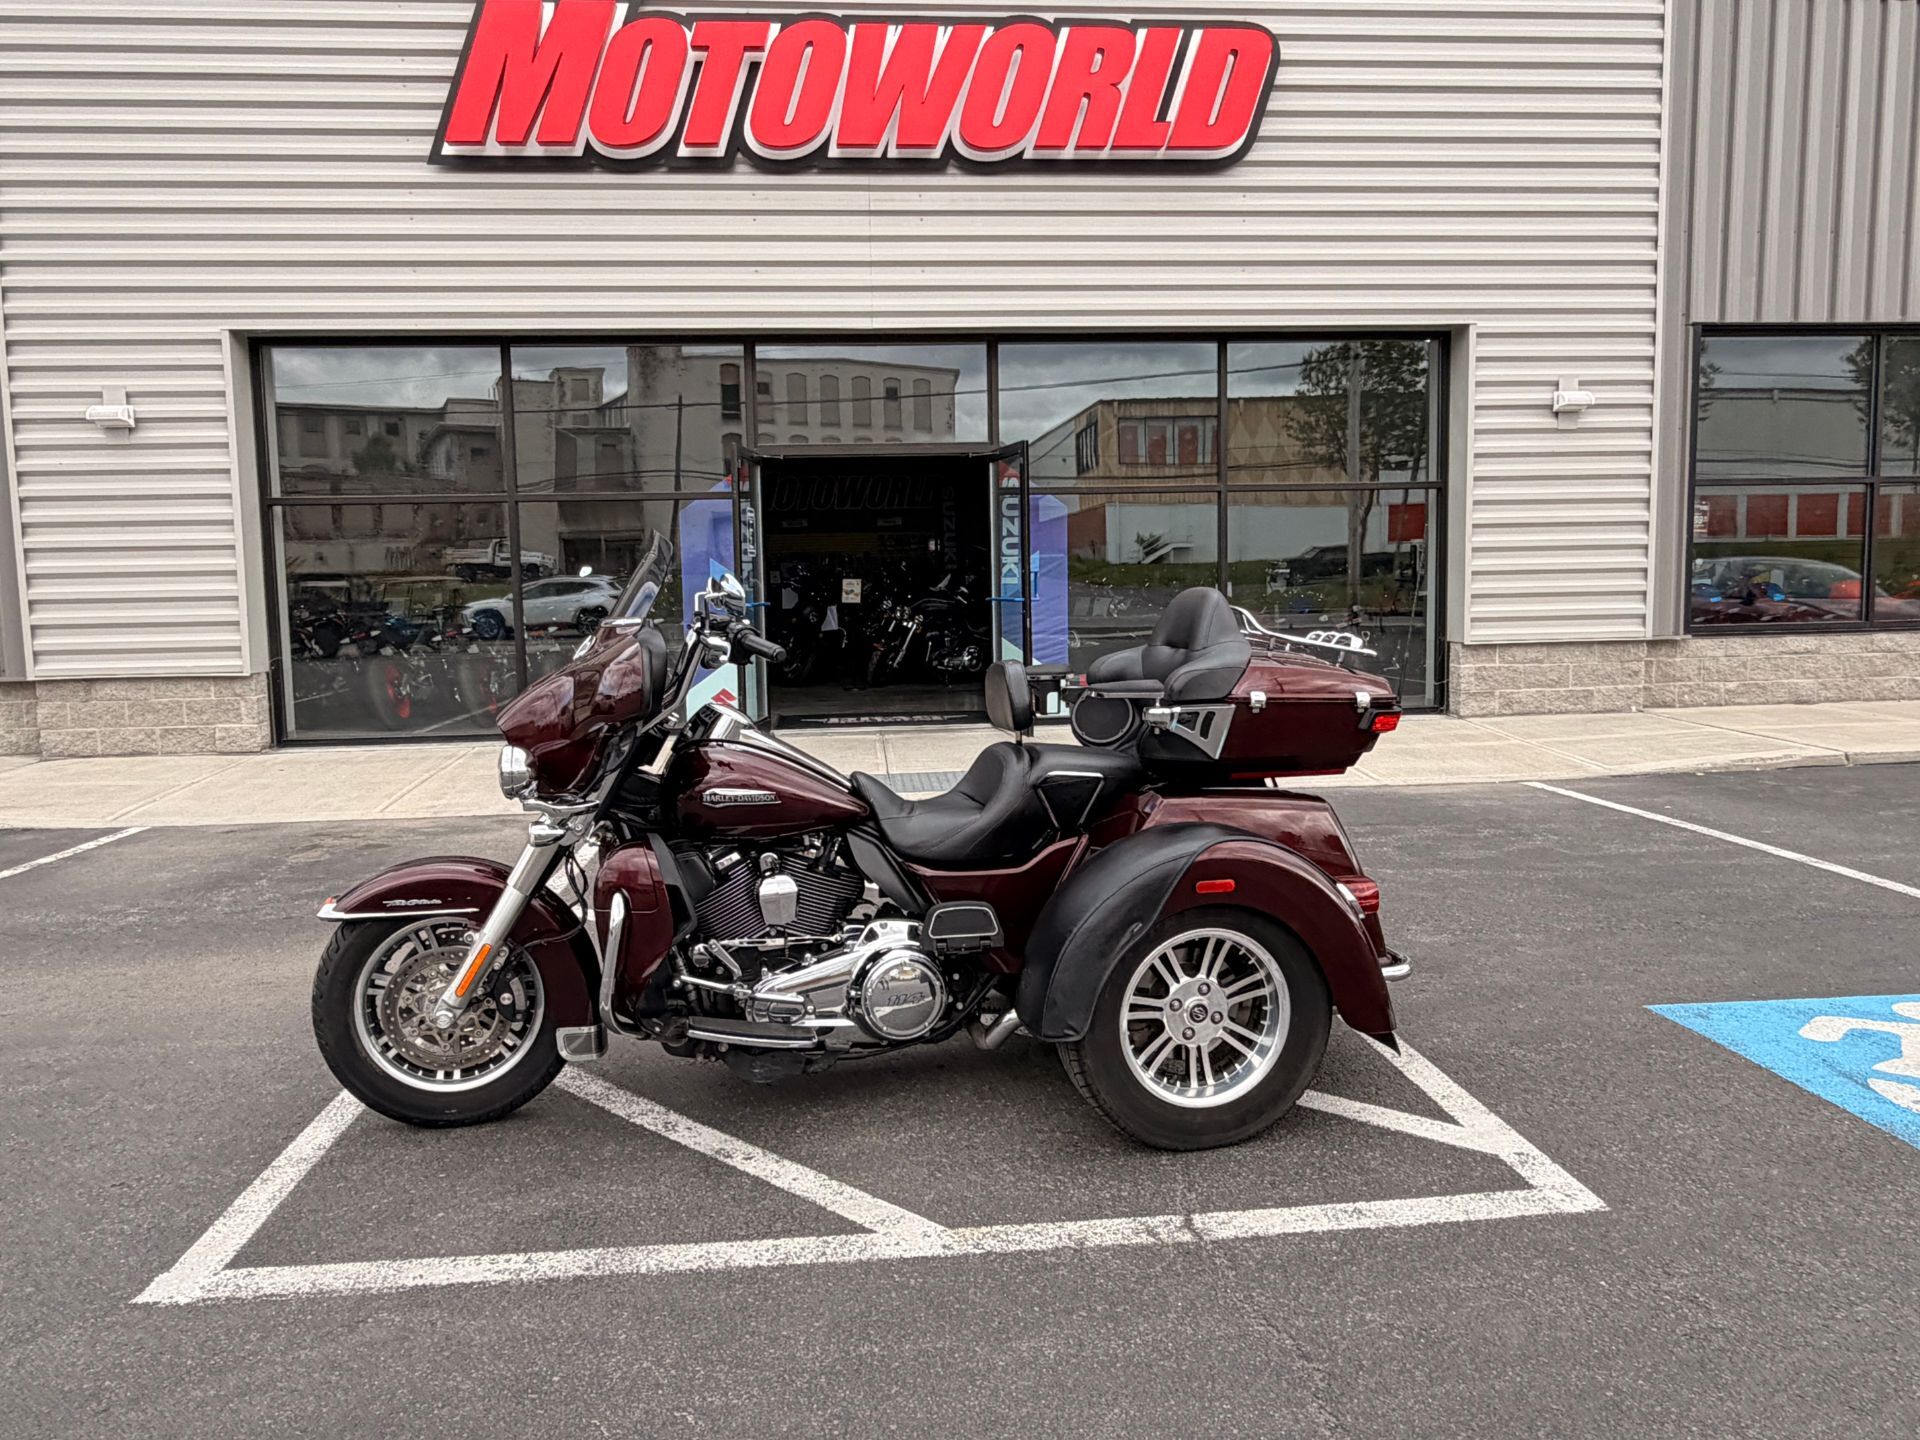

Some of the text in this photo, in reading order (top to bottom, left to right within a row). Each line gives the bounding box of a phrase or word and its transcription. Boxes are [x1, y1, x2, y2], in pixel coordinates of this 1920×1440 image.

[439, 0, 1275, 161] MOTOWORLD
[1001, 477, 1020, 585] SUZUKI
[703, 793, 777, 803] HARLEY-DAVIDSON
